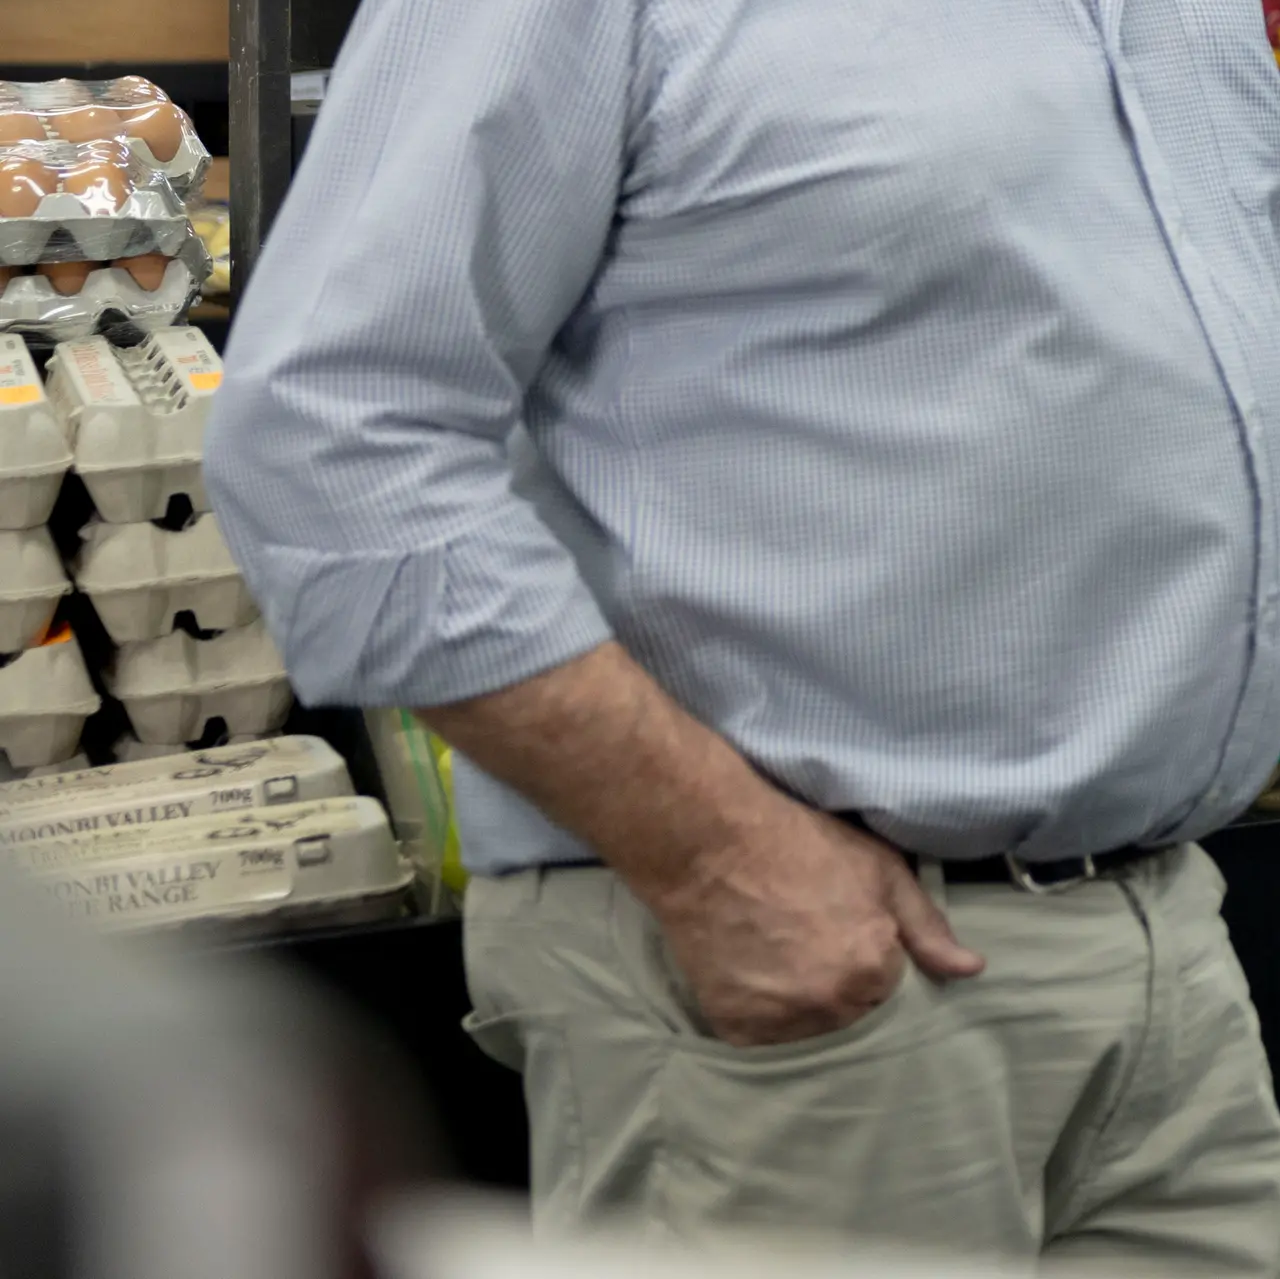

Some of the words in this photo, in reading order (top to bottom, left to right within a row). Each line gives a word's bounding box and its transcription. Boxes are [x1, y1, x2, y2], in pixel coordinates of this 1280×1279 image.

[209, 786, 253, 806] 700g
[104, 800, 195, 828] VALLEY
[125, 859, 223, 888] VALLEY
[108, 885, 199, 915] RANGE
